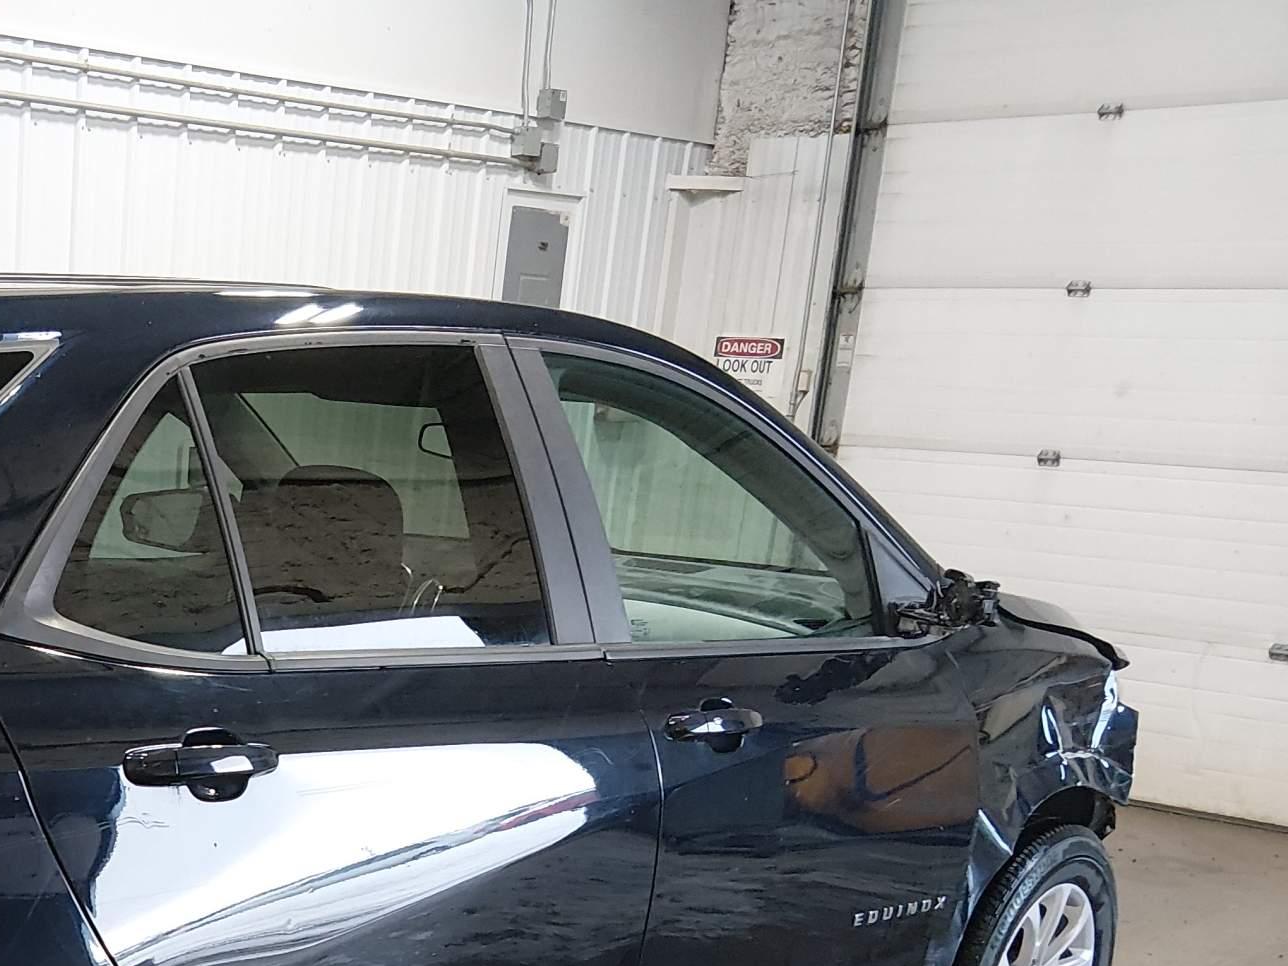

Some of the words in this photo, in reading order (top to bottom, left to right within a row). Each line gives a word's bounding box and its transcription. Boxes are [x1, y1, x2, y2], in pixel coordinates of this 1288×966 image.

[721, 341, 772, 354] DANGER
[751, 359, 774, 374] OUT
[853, 896, 947, 927] EQUINOX
